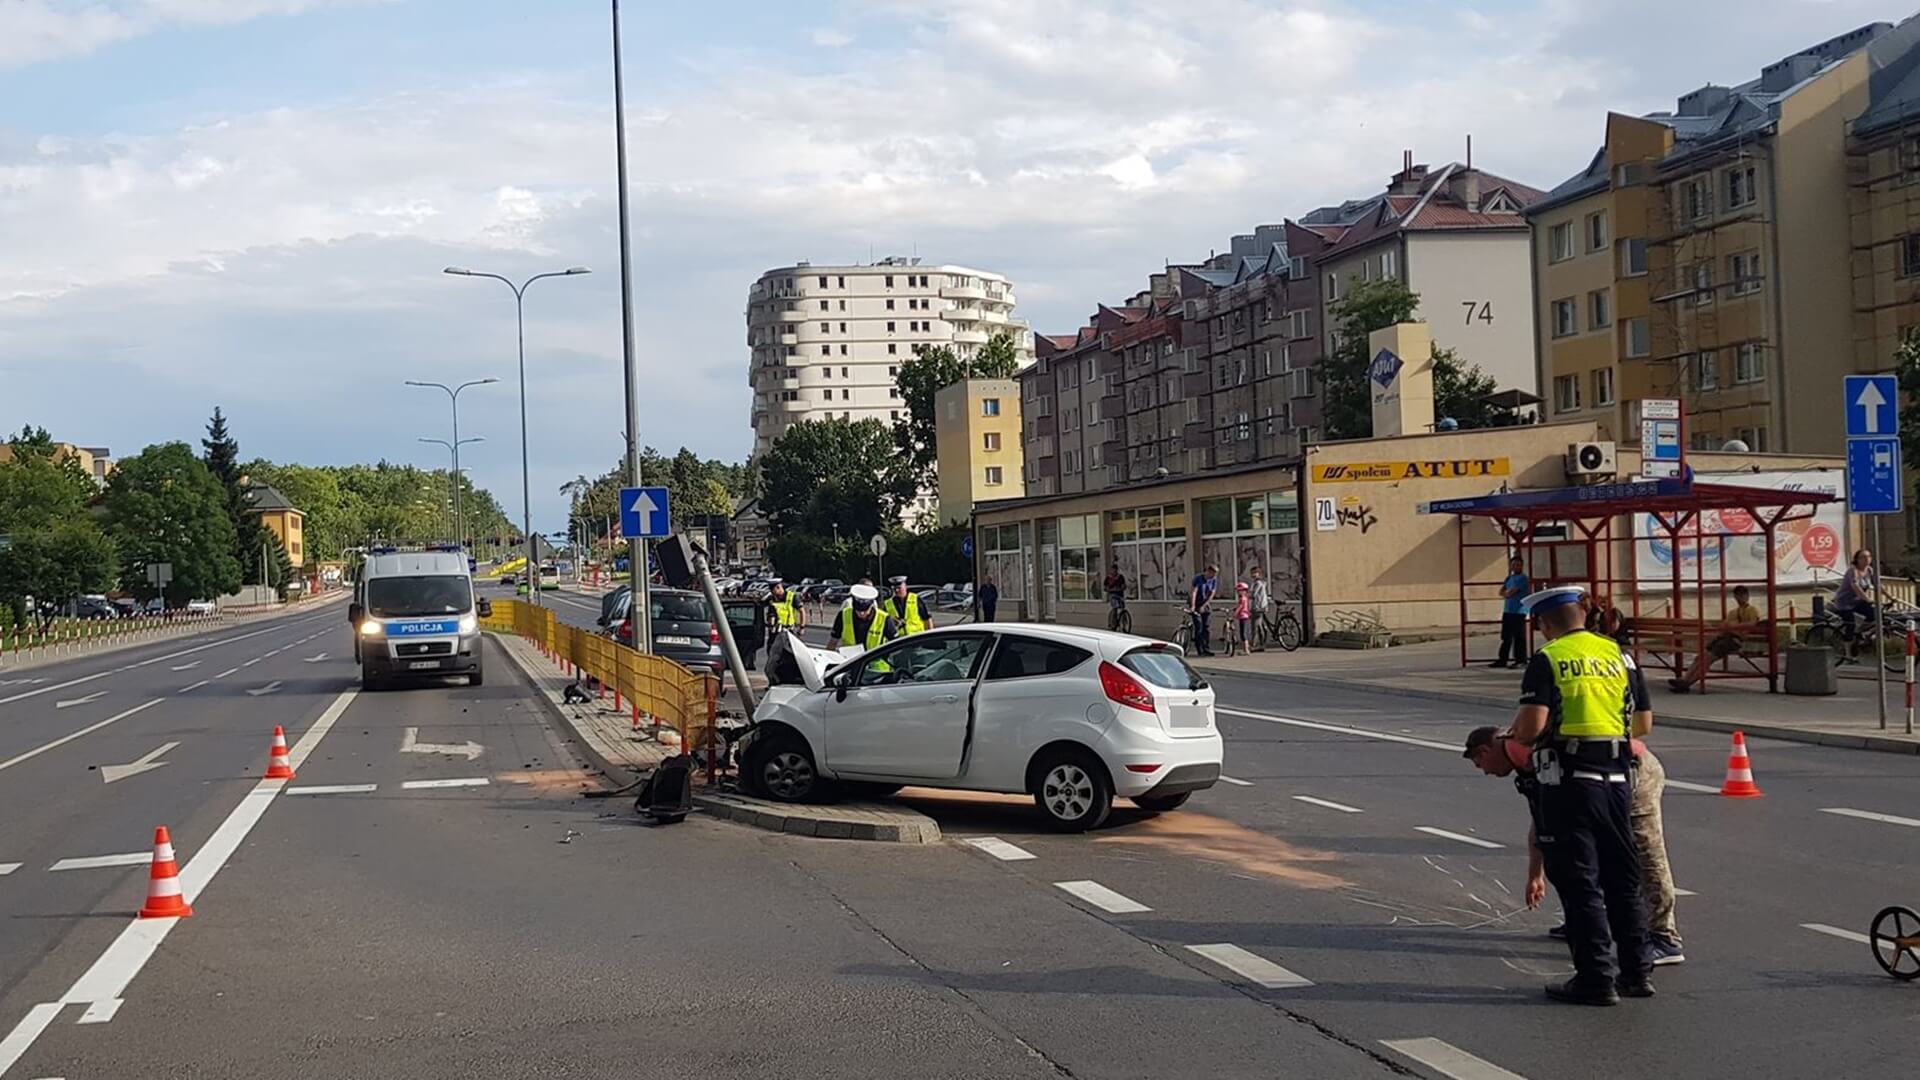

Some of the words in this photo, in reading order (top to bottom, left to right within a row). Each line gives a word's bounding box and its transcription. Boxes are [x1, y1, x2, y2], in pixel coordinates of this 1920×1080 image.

[1462, 301, 1494, 325] 74
[1402, 460, 1494, 477] ATUT
[402, 624, 443, 633] POLICJA
